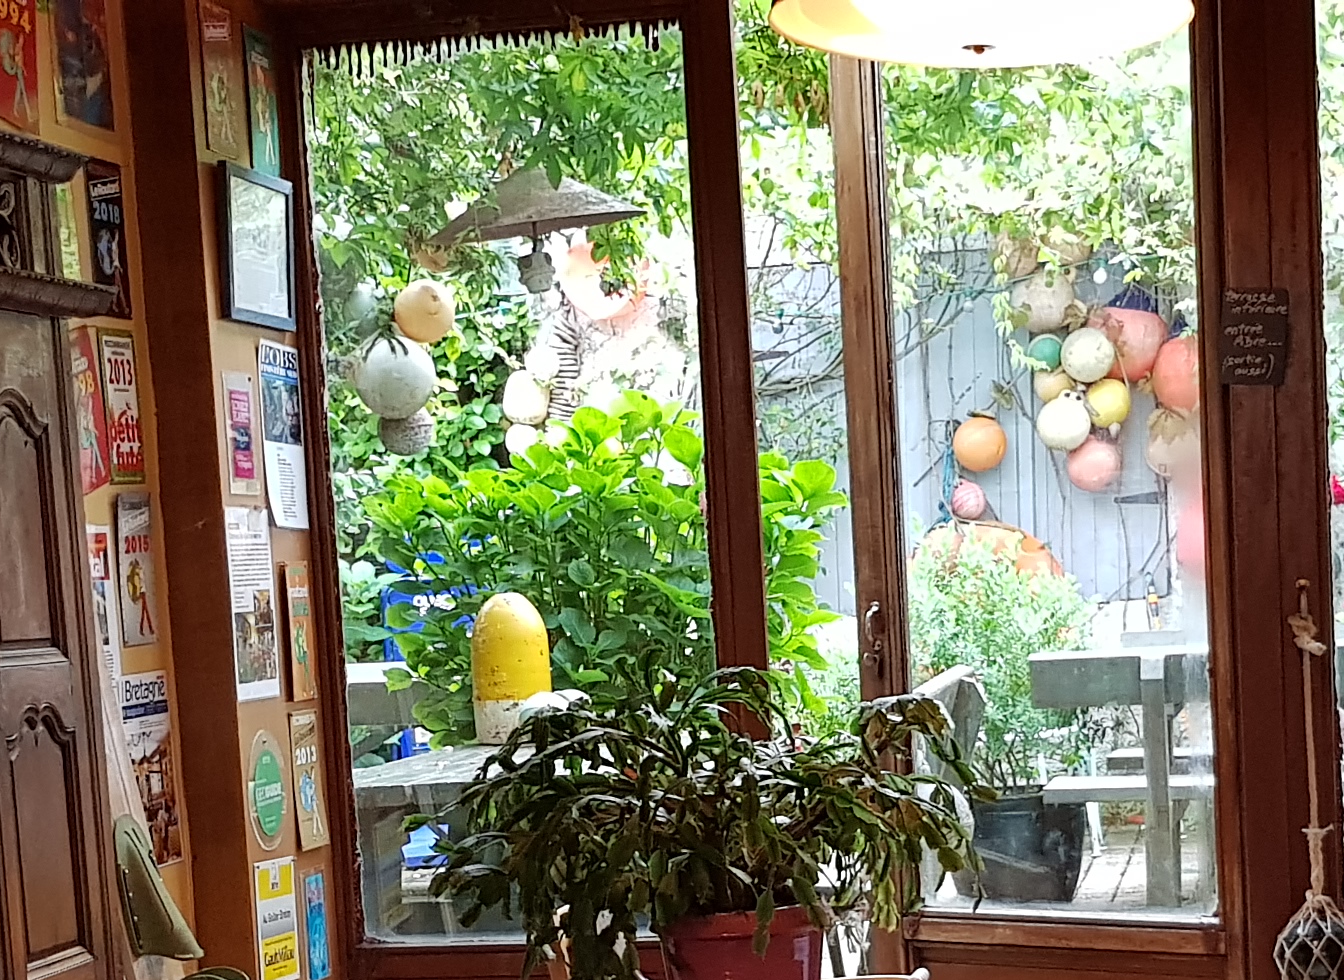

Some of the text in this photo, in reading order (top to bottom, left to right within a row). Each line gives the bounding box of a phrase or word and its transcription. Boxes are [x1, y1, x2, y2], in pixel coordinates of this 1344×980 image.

[107, 357, 133, 387] 2013
[124, 534, 150, 555] 2015
[124, 680, 166, 703] Bretagne
[295, 744, 317, 766] 2013
